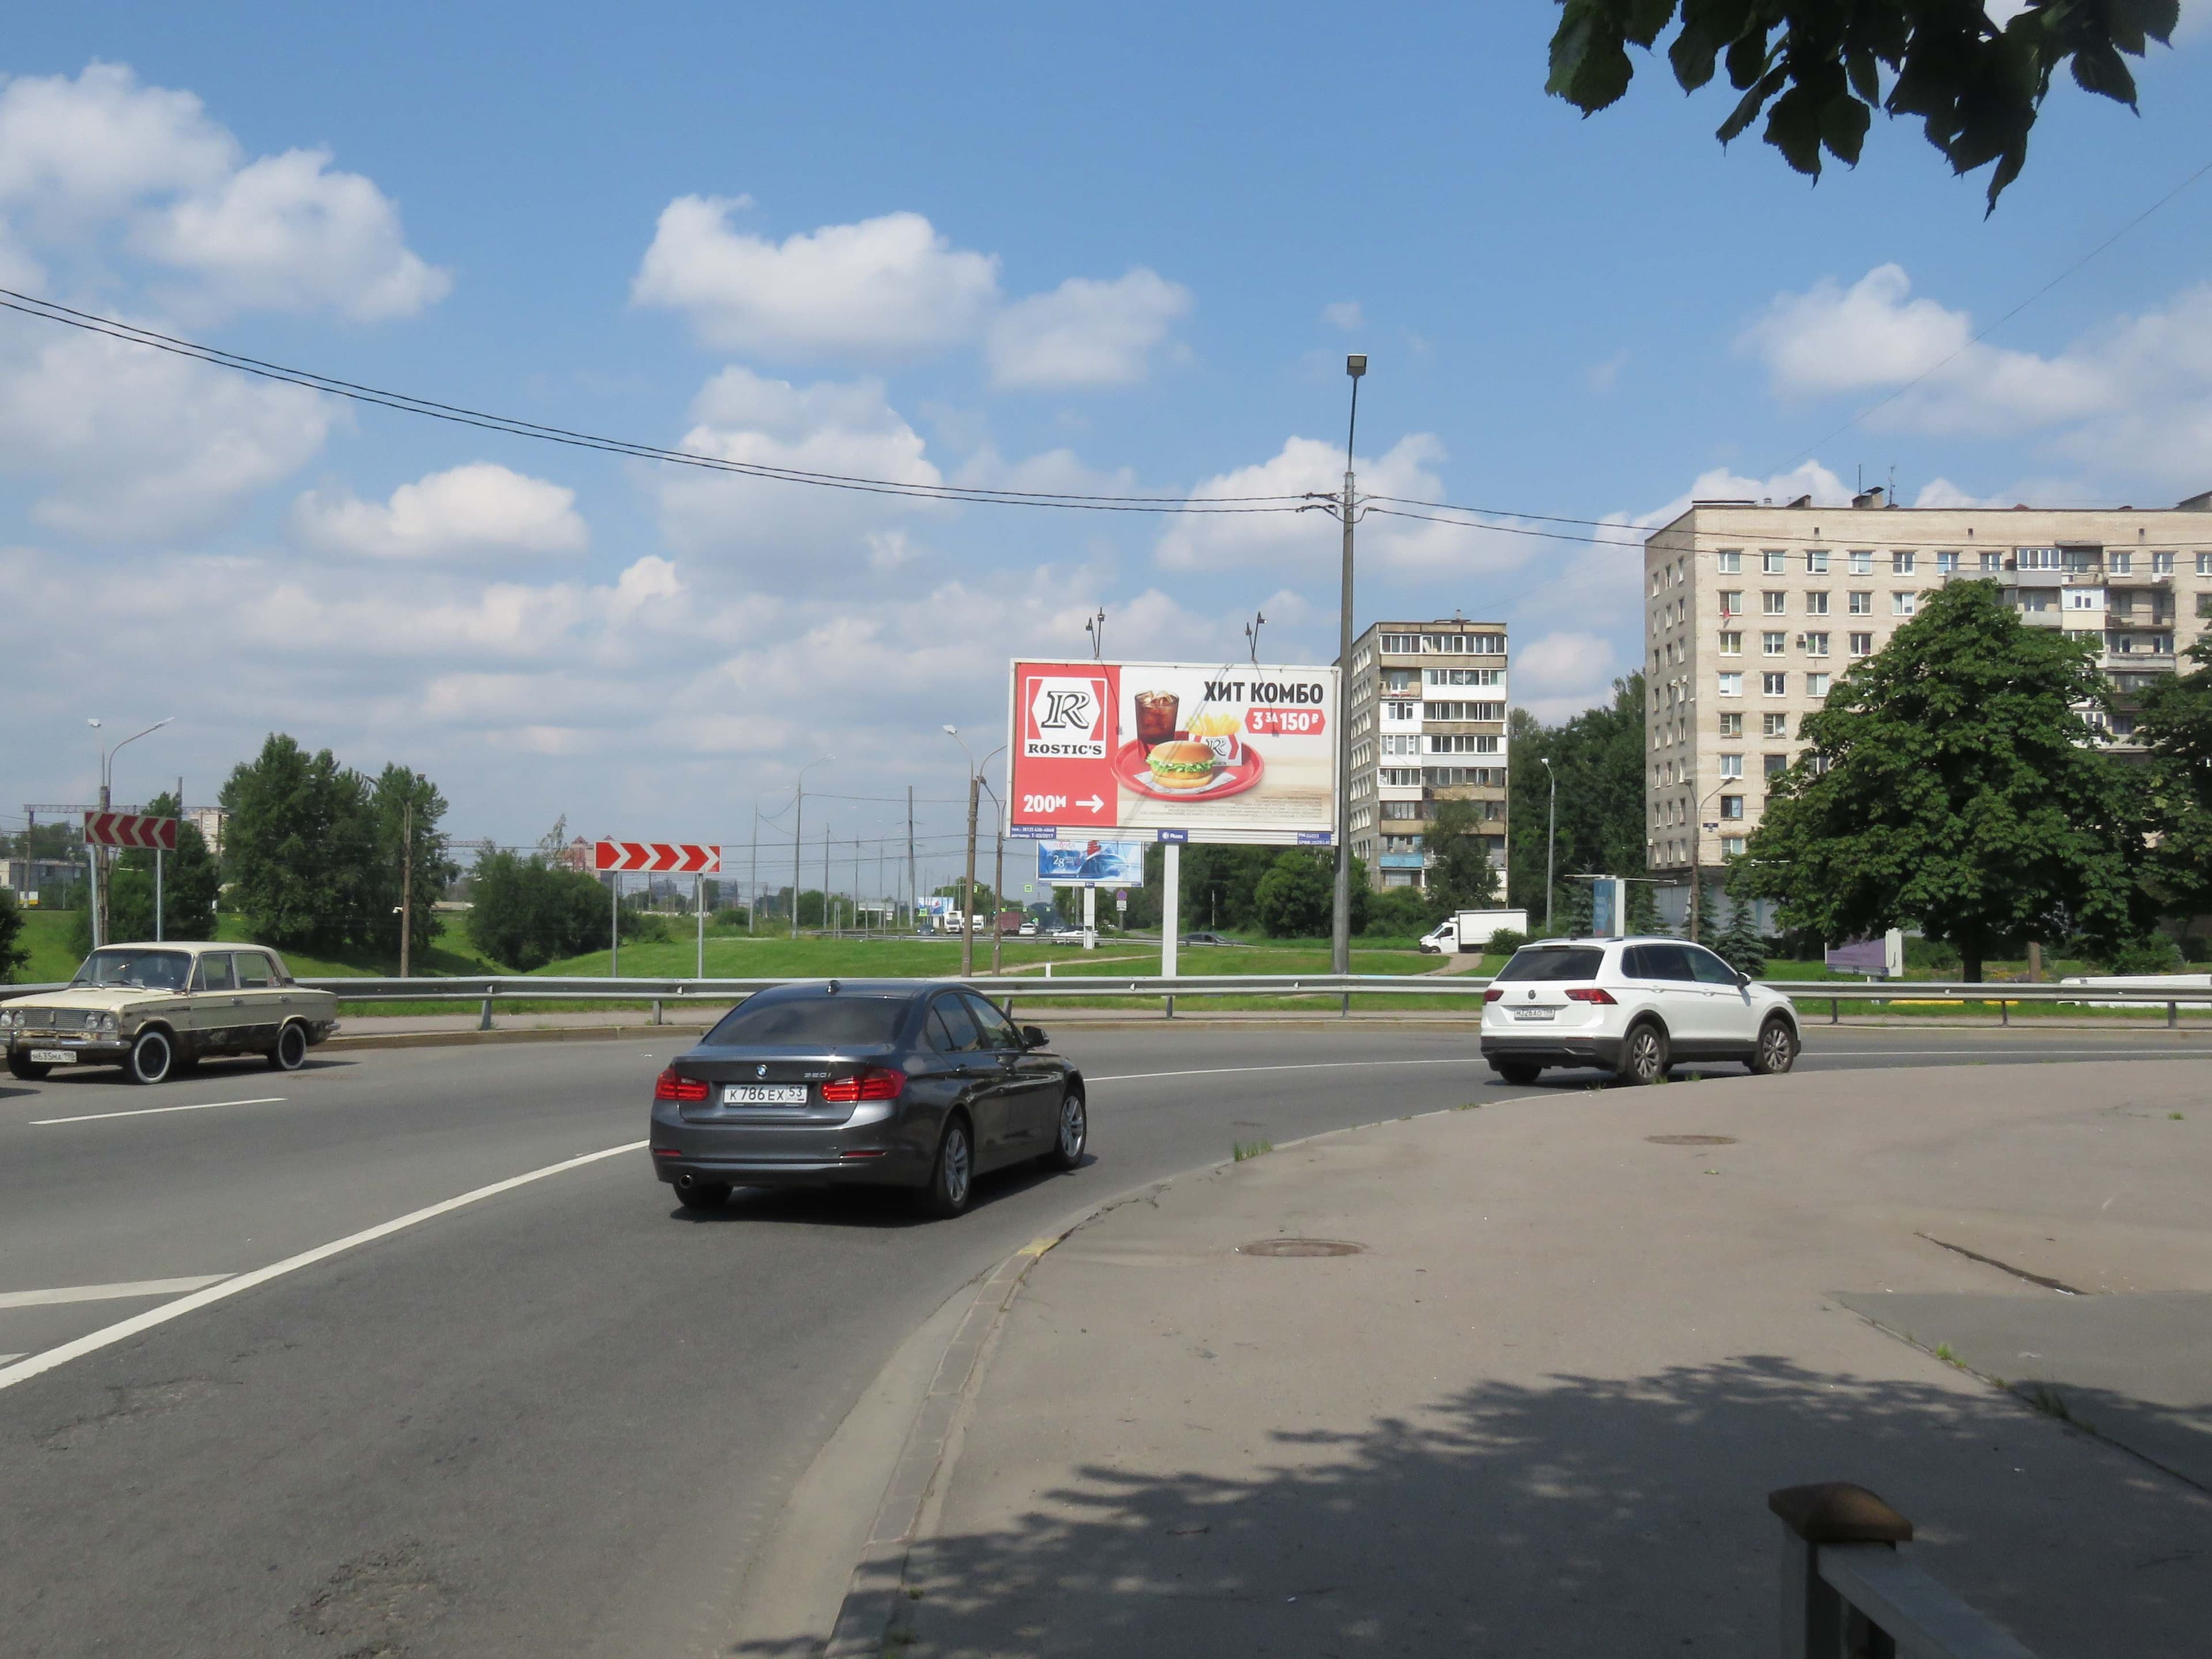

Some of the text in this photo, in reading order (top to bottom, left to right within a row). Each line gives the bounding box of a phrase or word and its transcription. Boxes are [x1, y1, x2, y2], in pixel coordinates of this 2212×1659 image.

[1204, 681, 1323, 704] ХИТ КОМБО
[1041, 691, 1090, 729] R
[1028, 744, 1102, 755] ROSTIC'S
[789, 1086, 802, 1097] 53
